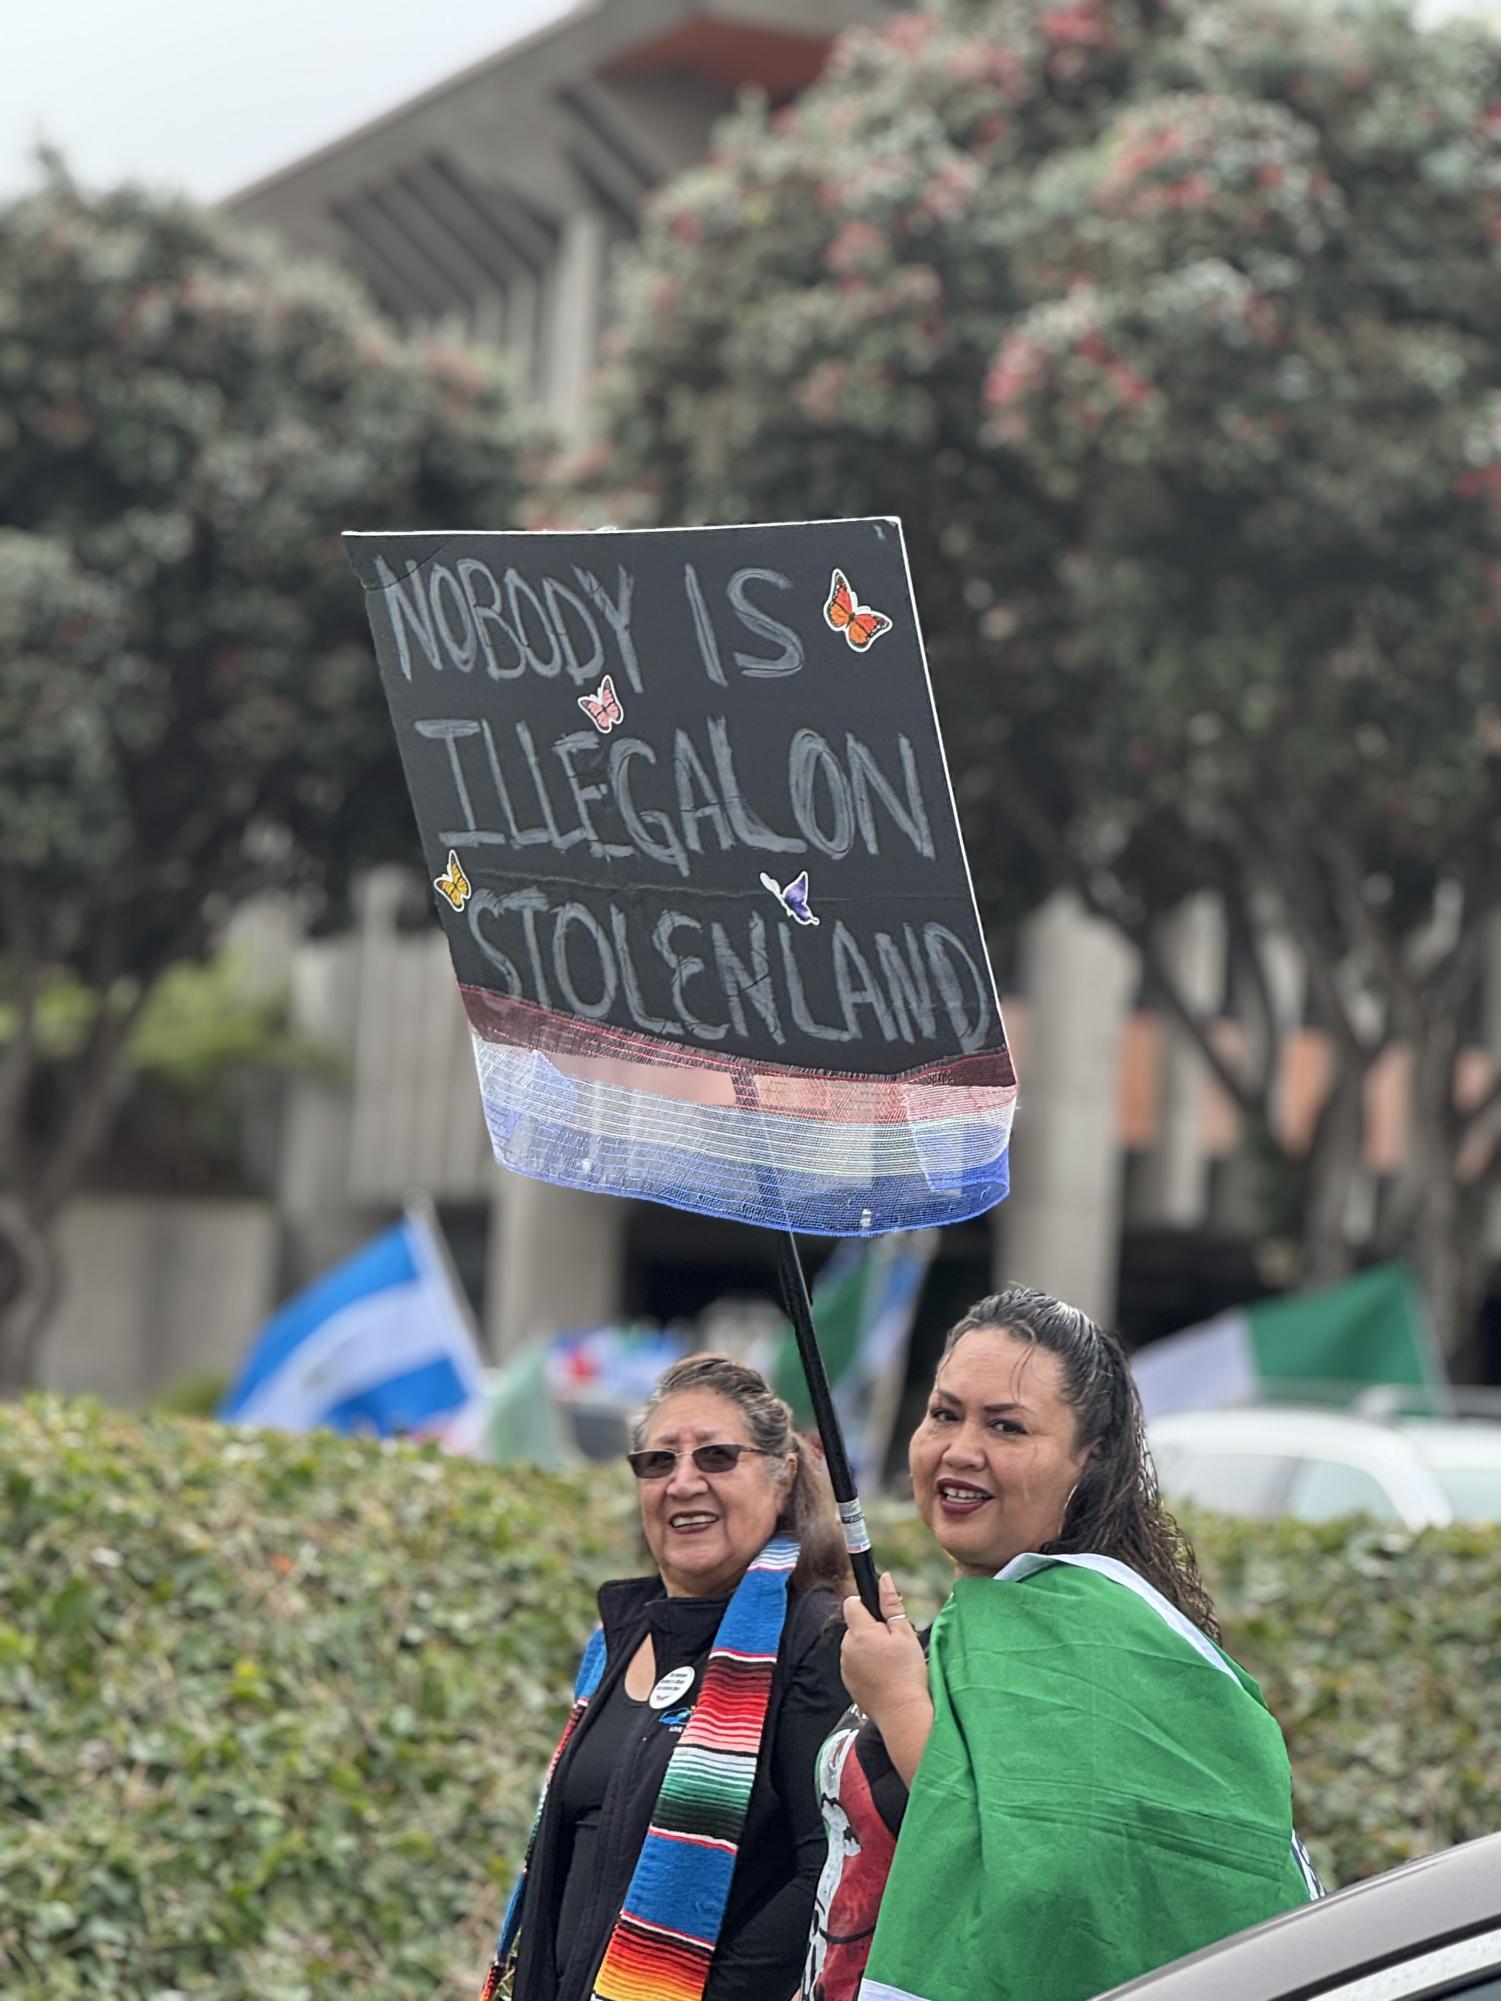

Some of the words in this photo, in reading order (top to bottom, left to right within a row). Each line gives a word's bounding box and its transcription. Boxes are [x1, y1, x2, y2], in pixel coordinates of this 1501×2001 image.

[374, 554, 645, 694] NOBODY
[683, 564, 803, 687] IS
[414, 715, 808, 878] ILLEGAL
[789, 727, 936, 860] ON
[468, 886, 787, 1046] STOLEN
[777, 919, 990, 1054] LAND
